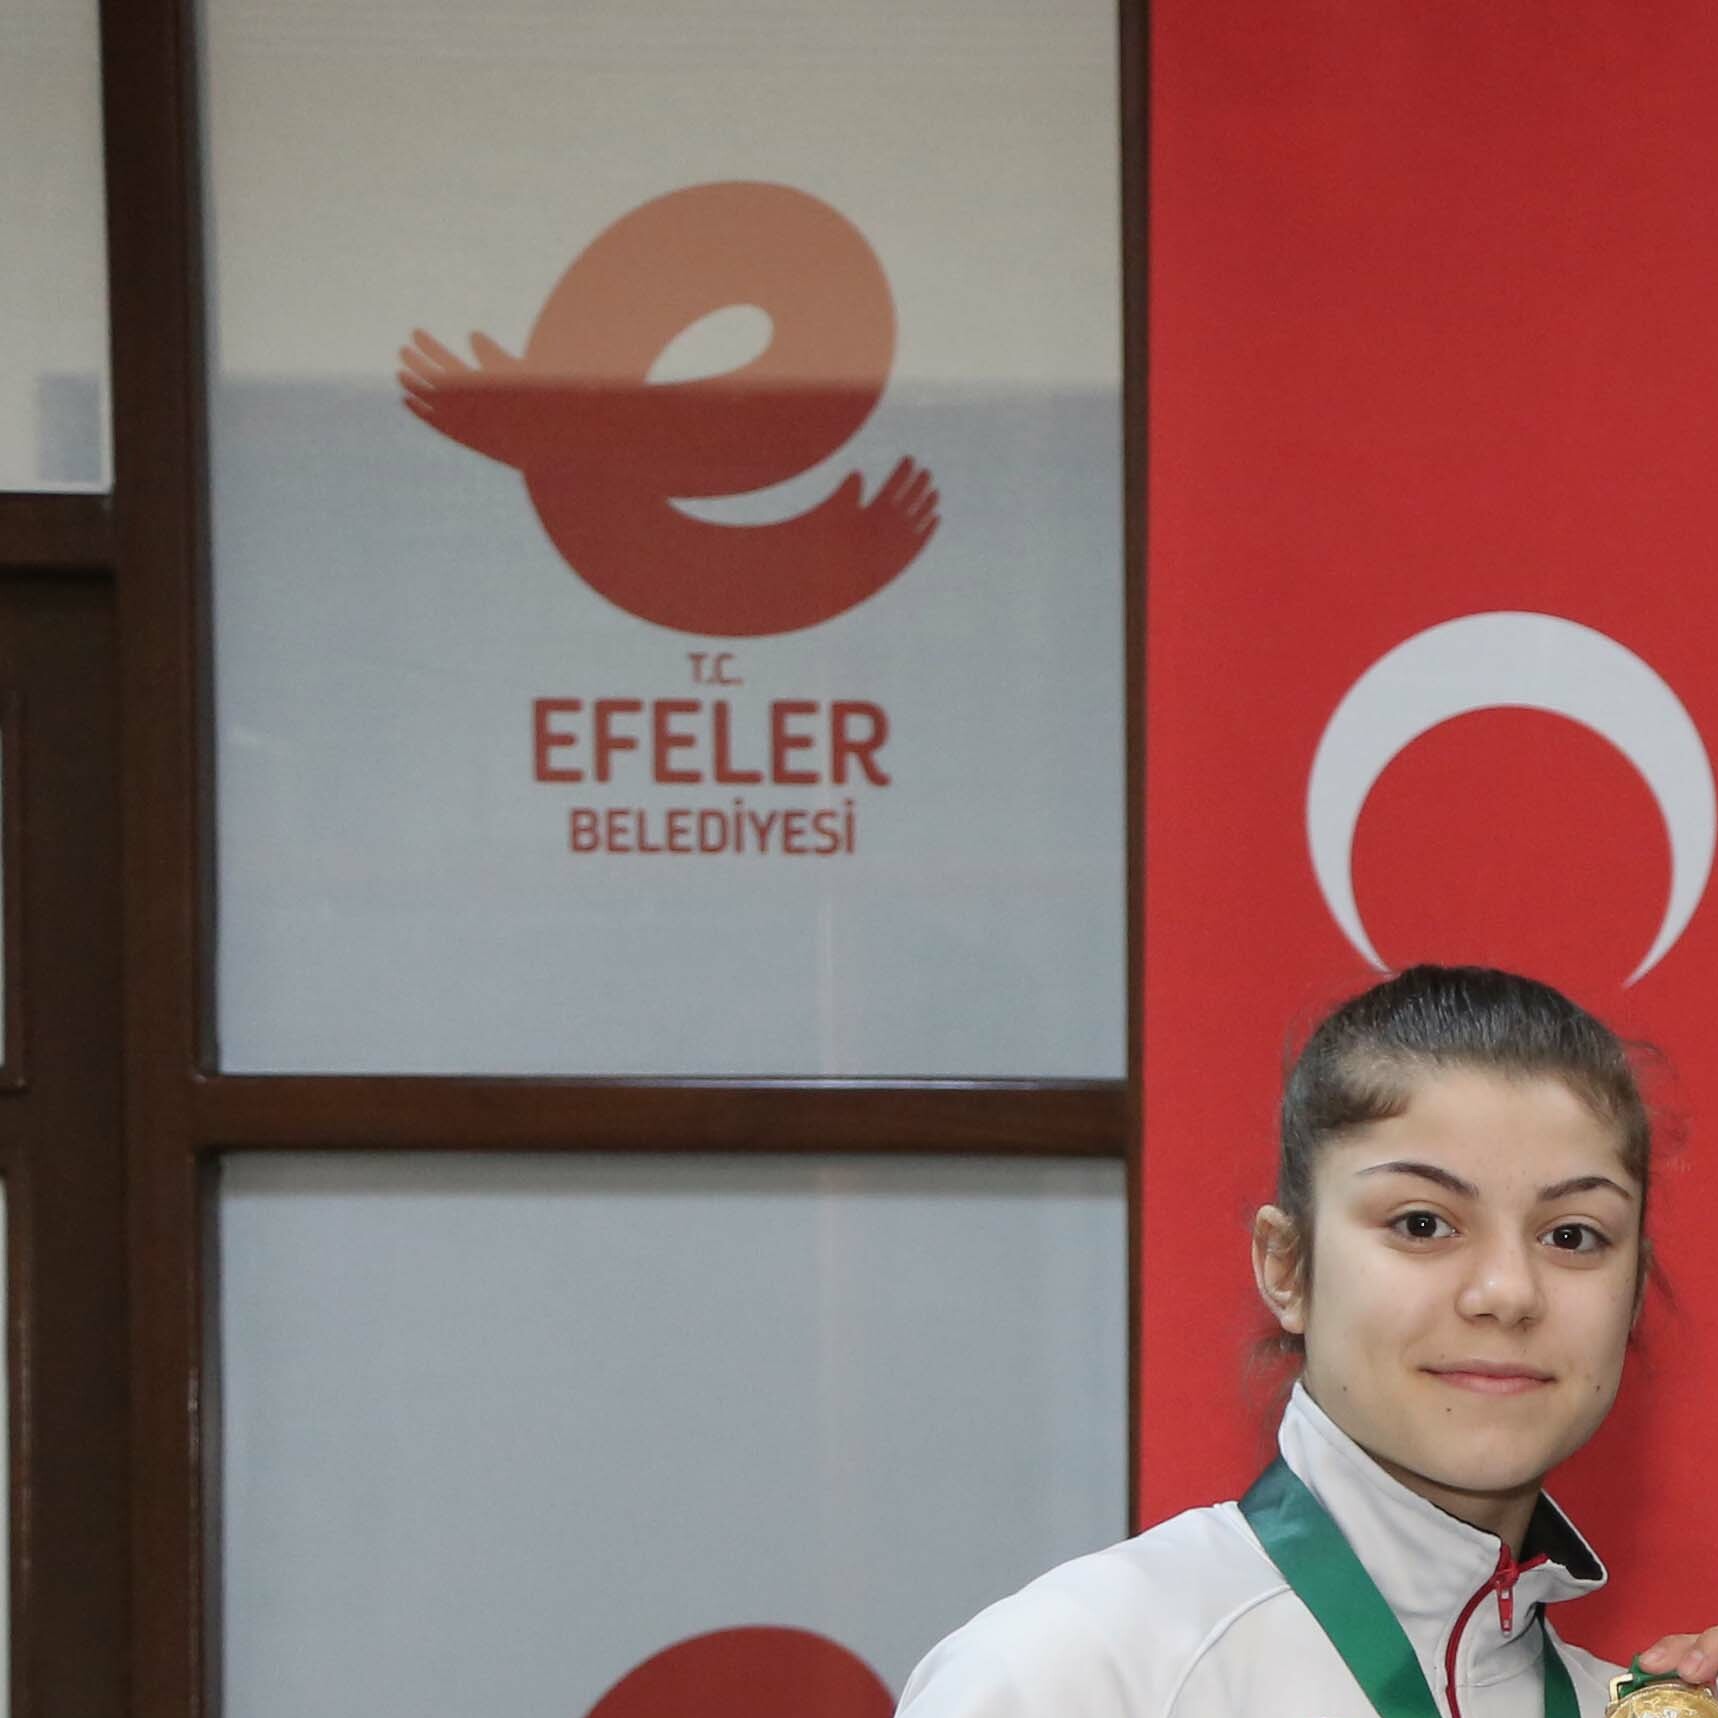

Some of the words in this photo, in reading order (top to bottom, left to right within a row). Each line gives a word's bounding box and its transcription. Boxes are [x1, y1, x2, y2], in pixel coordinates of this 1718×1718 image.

[687, 651, 743, 685] T.C.
[533, 697, 891, 786] EFELER
[569, 797, 857, 855] BELEDİYESİ
